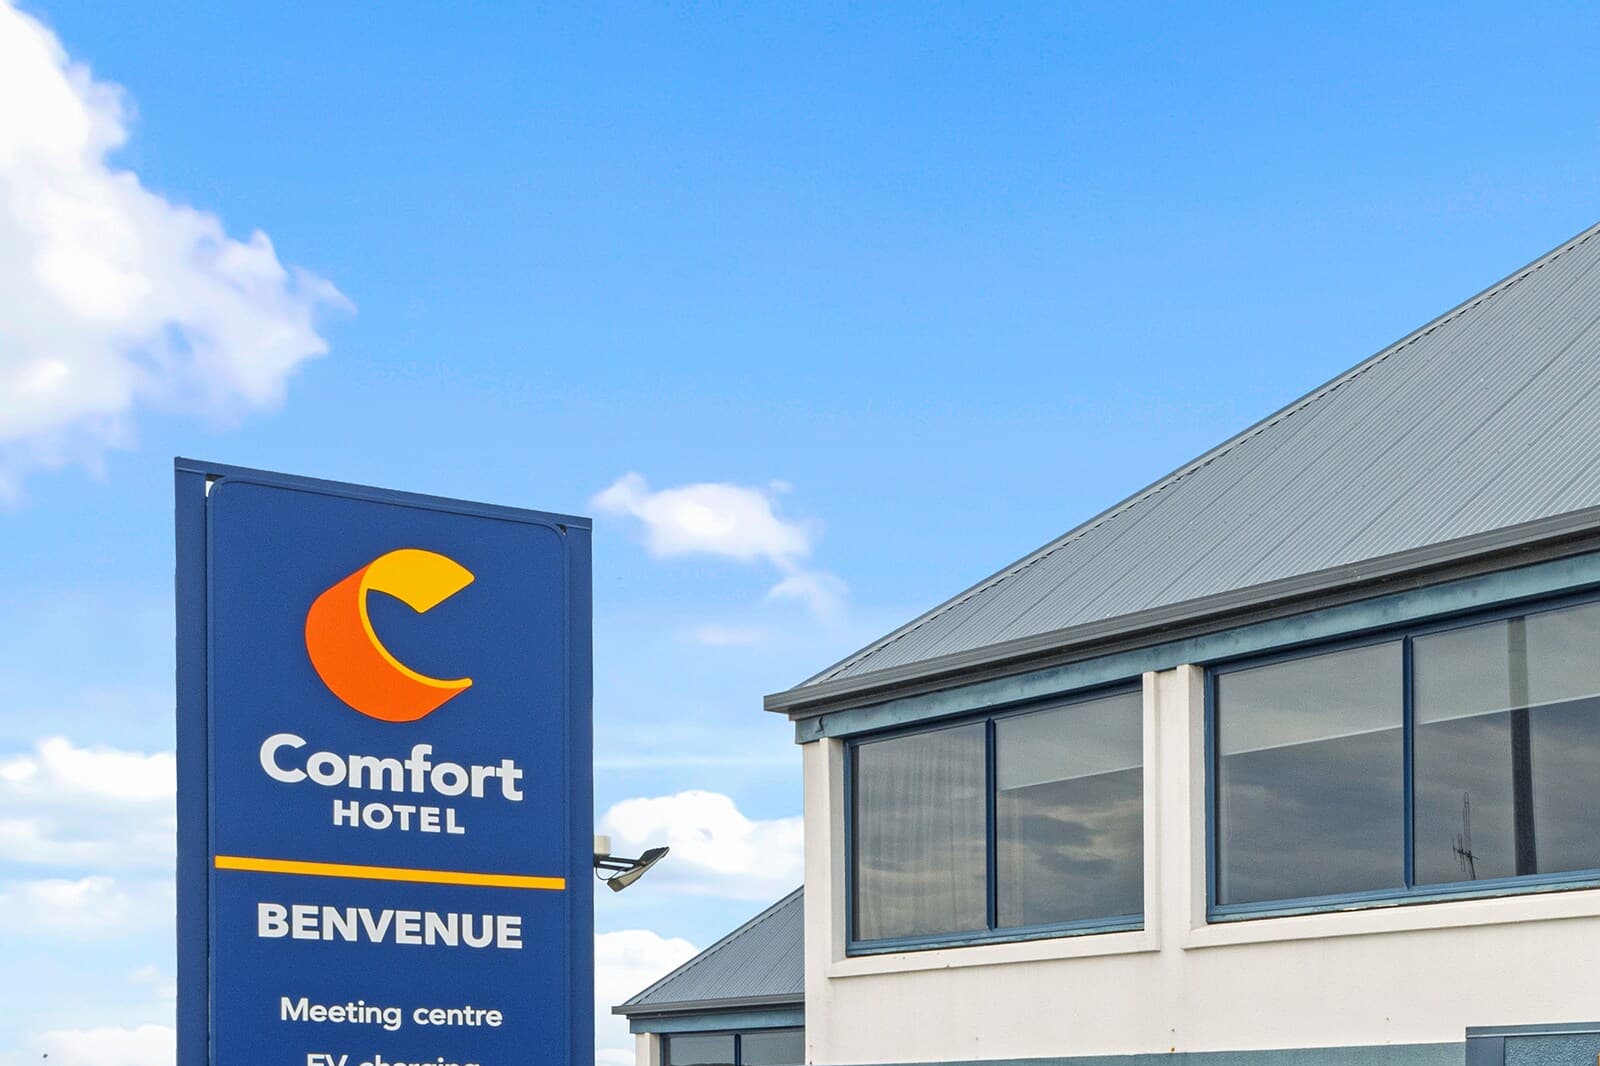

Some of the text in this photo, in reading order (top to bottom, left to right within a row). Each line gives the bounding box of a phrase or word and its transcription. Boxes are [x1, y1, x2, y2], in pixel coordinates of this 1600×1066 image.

[260, 733, 523, 801] Comfort
[333, 800, 465, 835] HOTEL
[258, 903, 523, 949] BENVENUE
[281, 997, 503, 1031] Meeting centre
